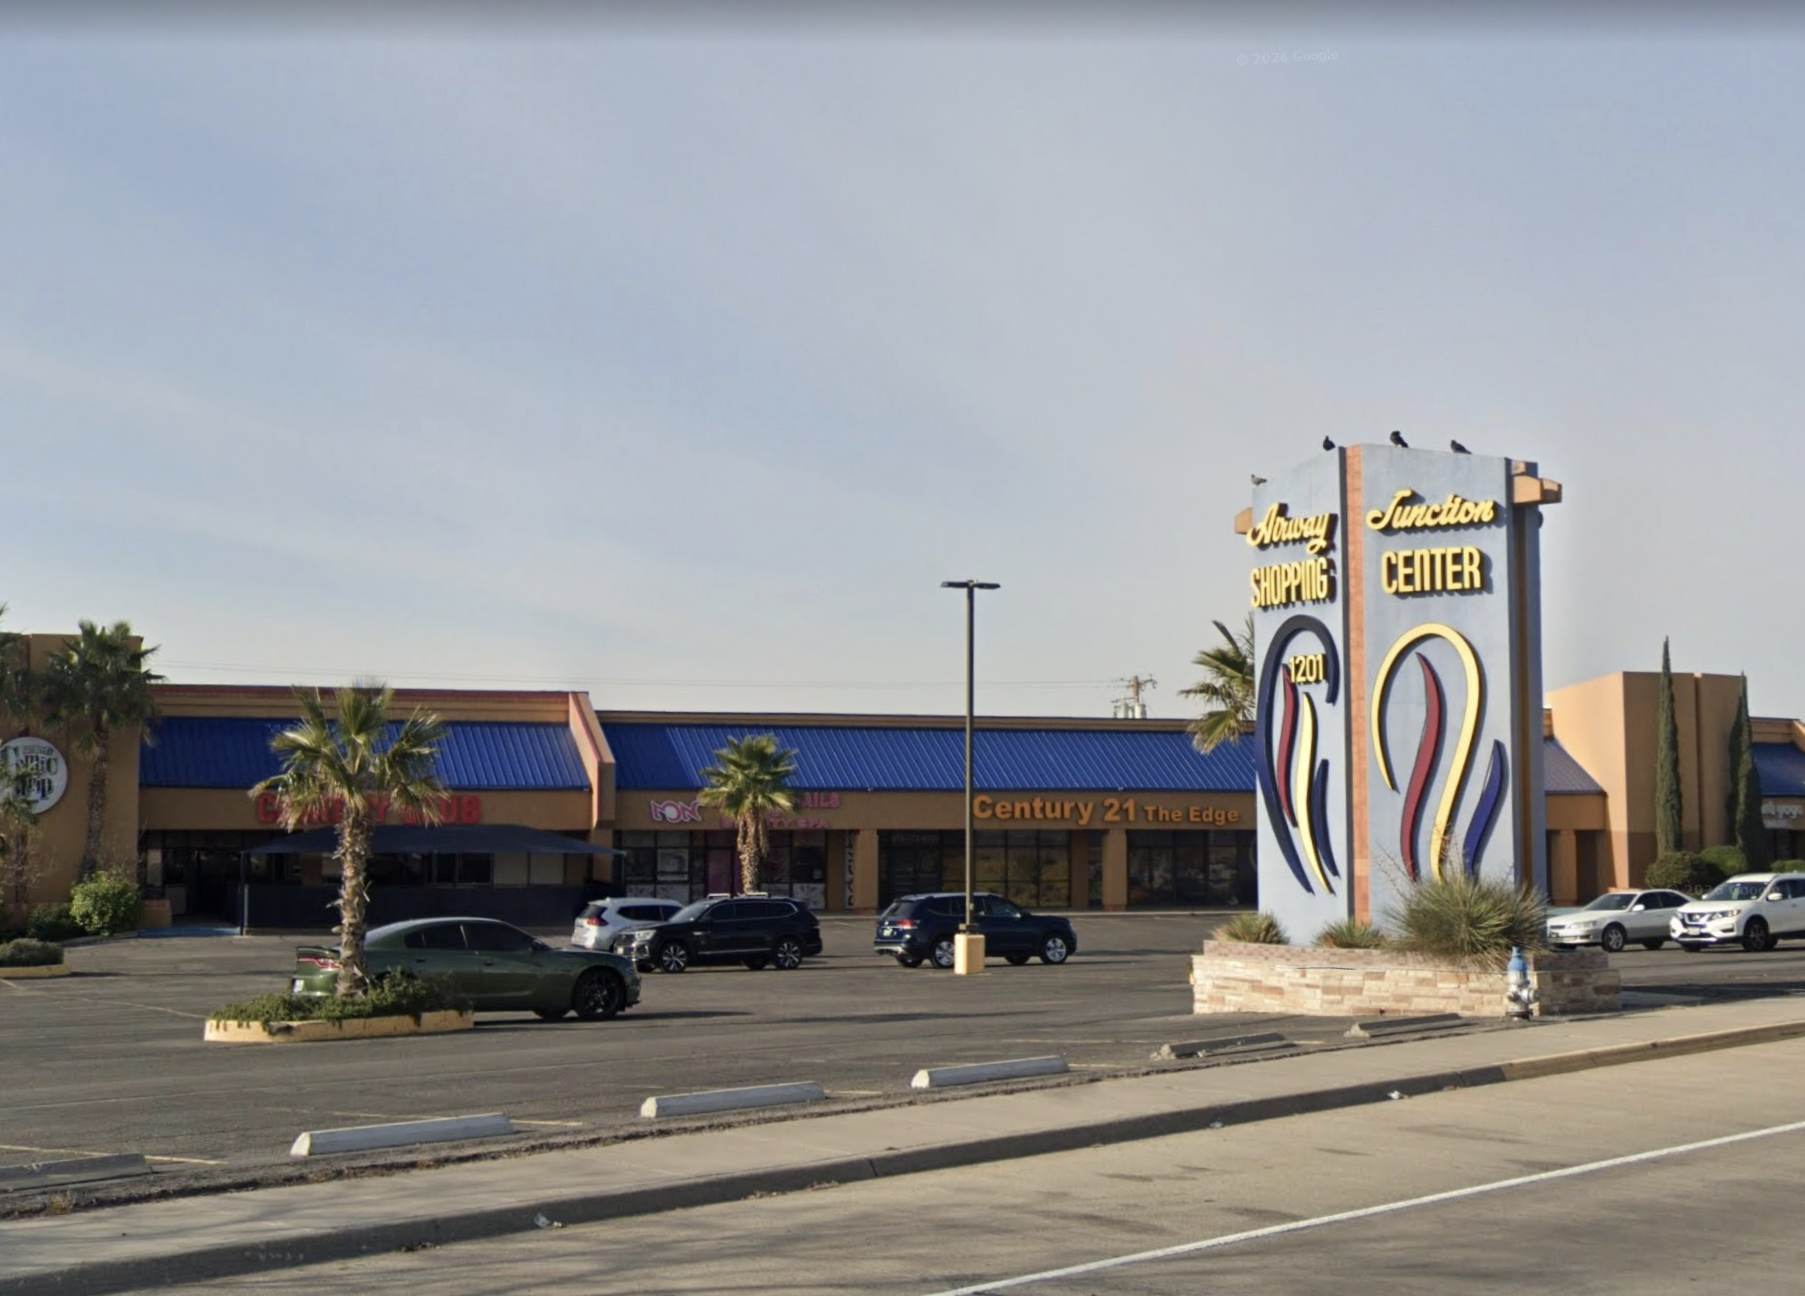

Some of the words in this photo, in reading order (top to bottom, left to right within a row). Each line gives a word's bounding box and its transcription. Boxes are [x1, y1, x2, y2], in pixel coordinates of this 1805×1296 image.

[1246, 502, 1330, 554] Airway
[1366, 489, 1495, 531] Junction
[1250, 557, 1329, 608] SHOPPING
[1381, 546, 1482, 594] CENTER
[1289, 654, 1325, 683] 1201
[403, 794, 482, 825] CUB
[796, 791, 840, 808] AILS
[973, 795, 1095, 825] Century
[1103, 798, 1137, 822] 21
[1144, 805, 1182, 822] The
[1189, 806, 1239, 826] Edge
